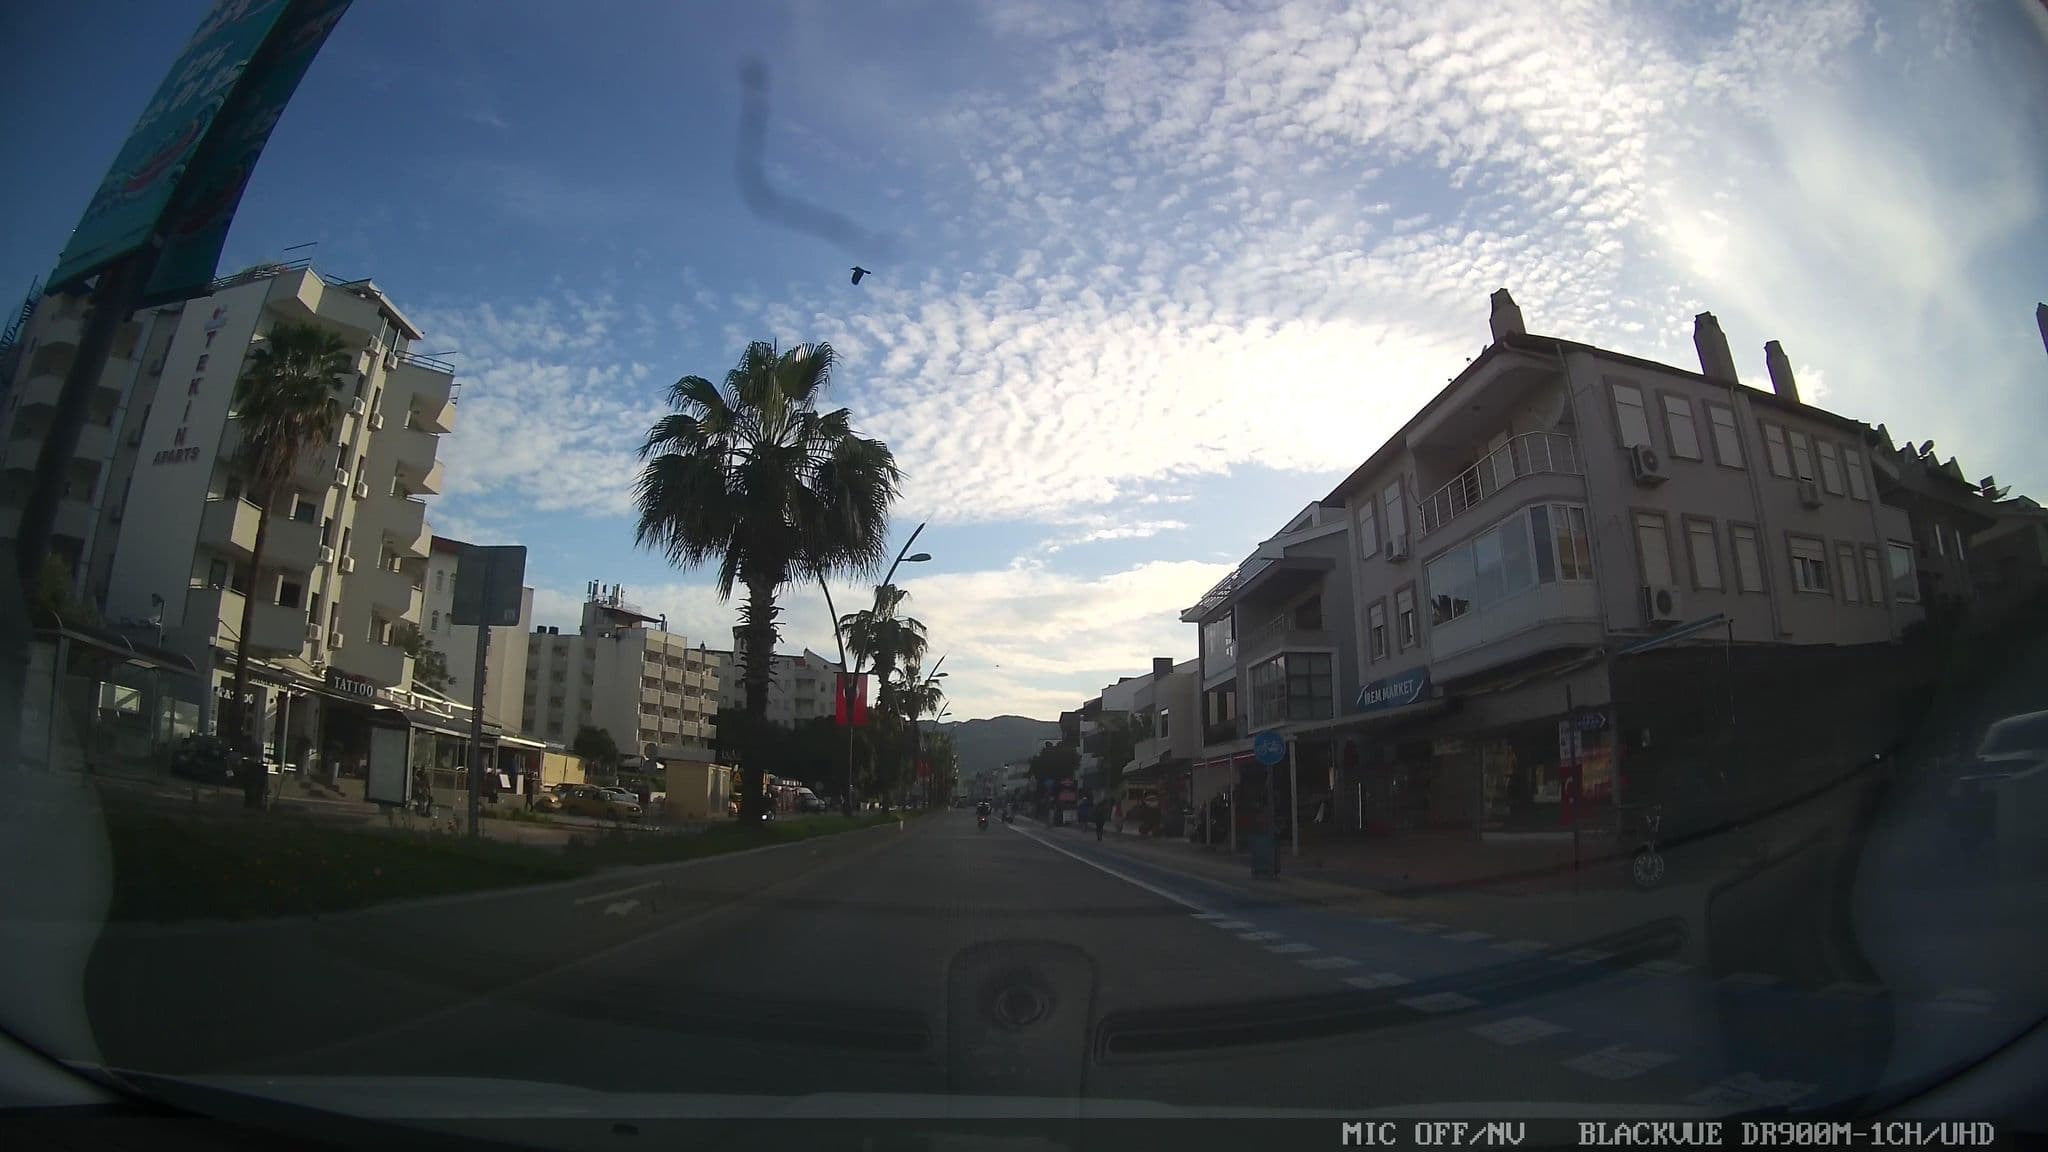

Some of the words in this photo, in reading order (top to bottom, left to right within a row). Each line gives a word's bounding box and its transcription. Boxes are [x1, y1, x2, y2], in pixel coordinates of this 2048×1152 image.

[153, 446, 200, 466] APARTS
[333, 676, 374, 699] TATTOO
[1382, 680, 1413, 701] MARKET
